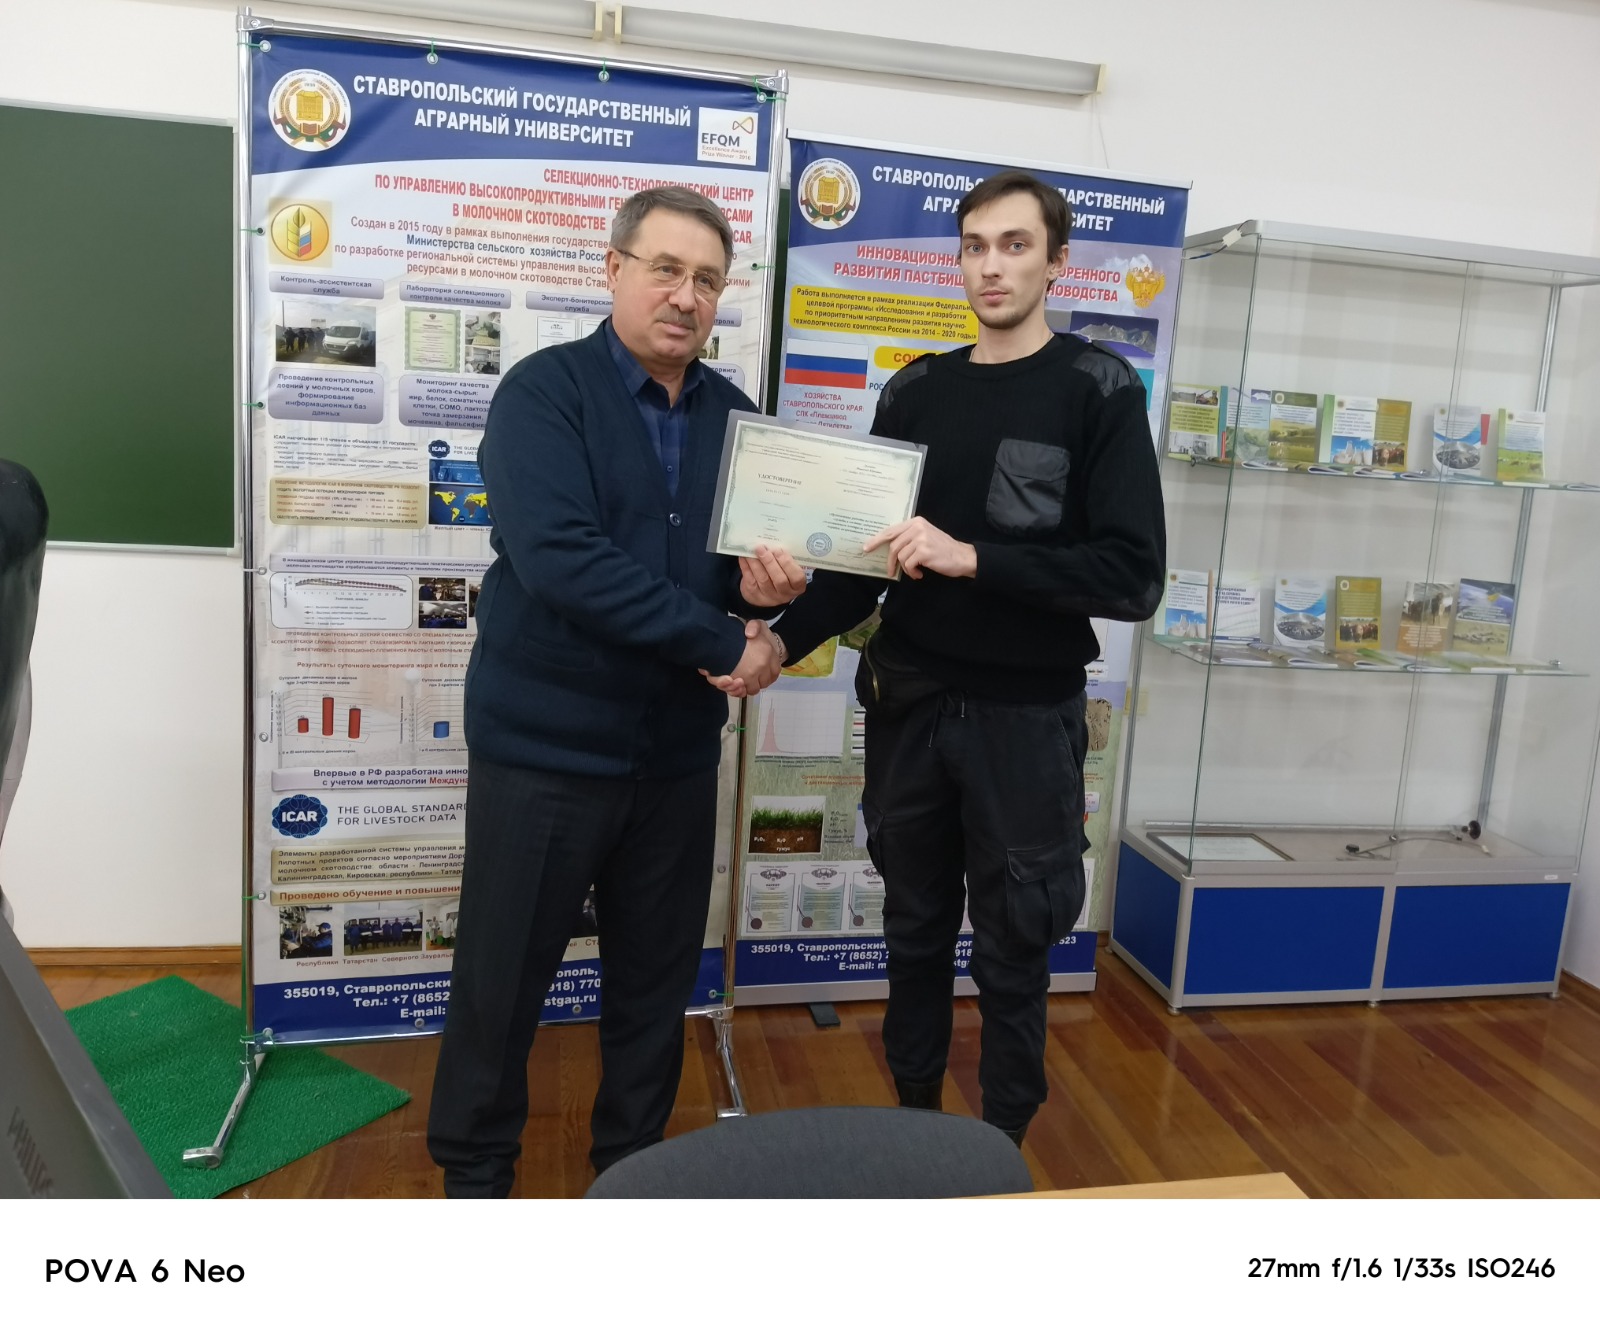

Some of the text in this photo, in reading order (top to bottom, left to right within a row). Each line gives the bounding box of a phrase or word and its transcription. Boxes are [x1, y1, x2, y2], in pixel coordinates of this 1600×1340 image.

[353, 75, 691, 127] СТАВРОПОЛЬСКИЙ ГОСУДАРСТВЕННЫЙ
[414, 108, 634, 148] АГРАРНЫЙ УНИВЕРСИТЕТ
[701, 132, 740, 147] EFQM
[375, 174, 390, 190] ПО
[393, 175, 466, 197] УПРАВЛЕНИЮ
[469, 181, 605, 209] ВЫСОКОПРОДУКТИВНЫМИ
[723, 185, 754, 203] ЦЕНТР
[452, 203, 606, 231] В МОЛОЧНОМ СКОТОВОДСТВЕ
[351, 216, 550, 243] Создан в 2015 году в рамках выполнения
[406, 234, 577, 260] Министерства сельского хозяйства
[334, 244, 347, 254] по
[349, 245, 404, 259] разработке
[406, 249, 474, 264] региональной
[477, 254, 518, 267] системы
[520, 258, 575, 273] управления
[856, 245, 961, 268] ИННОВАЦИОНН
[407, 263, 458, 278] ресурсами
[461, 267, 466, 275] в
[469, 268, 518, 281] молочном
[520, 272, 583, 287] скотоводстве
[833, 262, 901, 282] РАЗВИТИЯ
[280, 276, 372, 288] Контроль-ассистентская
[313, 286, 340, 296] служба
[406, 284, 505, 299] Лаборатория селекционного
[797, 288, 820, 297] Работа
[821, 291, 866, 302] выполняется
[873, 297, 895, 305] рамках
[896, 298, 934, 308] реализации
[564, 305, 590, 313] служба
[806, 300, 834, 309] целевой
[836, 303, 874, 313] программы
[875, 305, 925, 316] «Исследования
[932, 311, 967, 321] разработки
[814, 310, 863, 322] приоритетным
[864, 314, 911, 325] направлениям
[912, 319, 941, 328] развития
[942, 321, 967, 330] научно-
[793, 317, 851, 329] технологического
[852, 323, 887, 333] комплекса
[888, 326, 911, 334] России
[921, 328, 936, 336] 2014
[941, 330, 956, 338] 2020
[278, 373, 374, 385] Проведение контрольных
[416, 378, 458, 387] Мониторинг
[311, 385, 350, 394] молочных
[804, 391, 842, 401] ХОЗЯЙСТВА
[297, 391, 355, 402] формирование
[285, 400, 367, 410] информационных баз
[783, 400, 845, 411] СТАВРОПОЛЬСКОГО
[311, 409, 340, 417] данных
[297, 661, 336, 669] Результаты
[313, 769, 357, 778] Впервые
[367, 768, 383, 777] РФ
[384, 768, 443, 777] разработана
[330, 778, 364, 787] учетом
[366, 777, 427, 786] методологии
[281, 810, 318, 823] ICAR
[337, 805, 407, 815] THE GLOBAL
[337, 813, 457, 826] FOR LIVESTOCK DATA
[278, 849, 317, 857] Элементы
[319, 847, 376, 857] разработанной
[413, 845, 457, 853] управления
[278, 853, 447, 866] пилотных проектов согласно мероприятиям
[389, 870, 432, 878] республики
[279, 890, 340, 901] Проведено
[342, 888, 393, 900] обучение
[751, 941, 887, 954] 355019, Ставропольский
[296, 954, 419, 967] Республики Татарстан Северного
[803, 951, 882, 962] Тел.: +7 (8652)
[838, 961, 875, 971] E-mail:
[283, 966, 599, 998] 355019, Ставропольски ополь,
[353, 994, 408, 1008] Тел.: +7
[400, 993, 597, 1018] E-mail: stgau.ru
